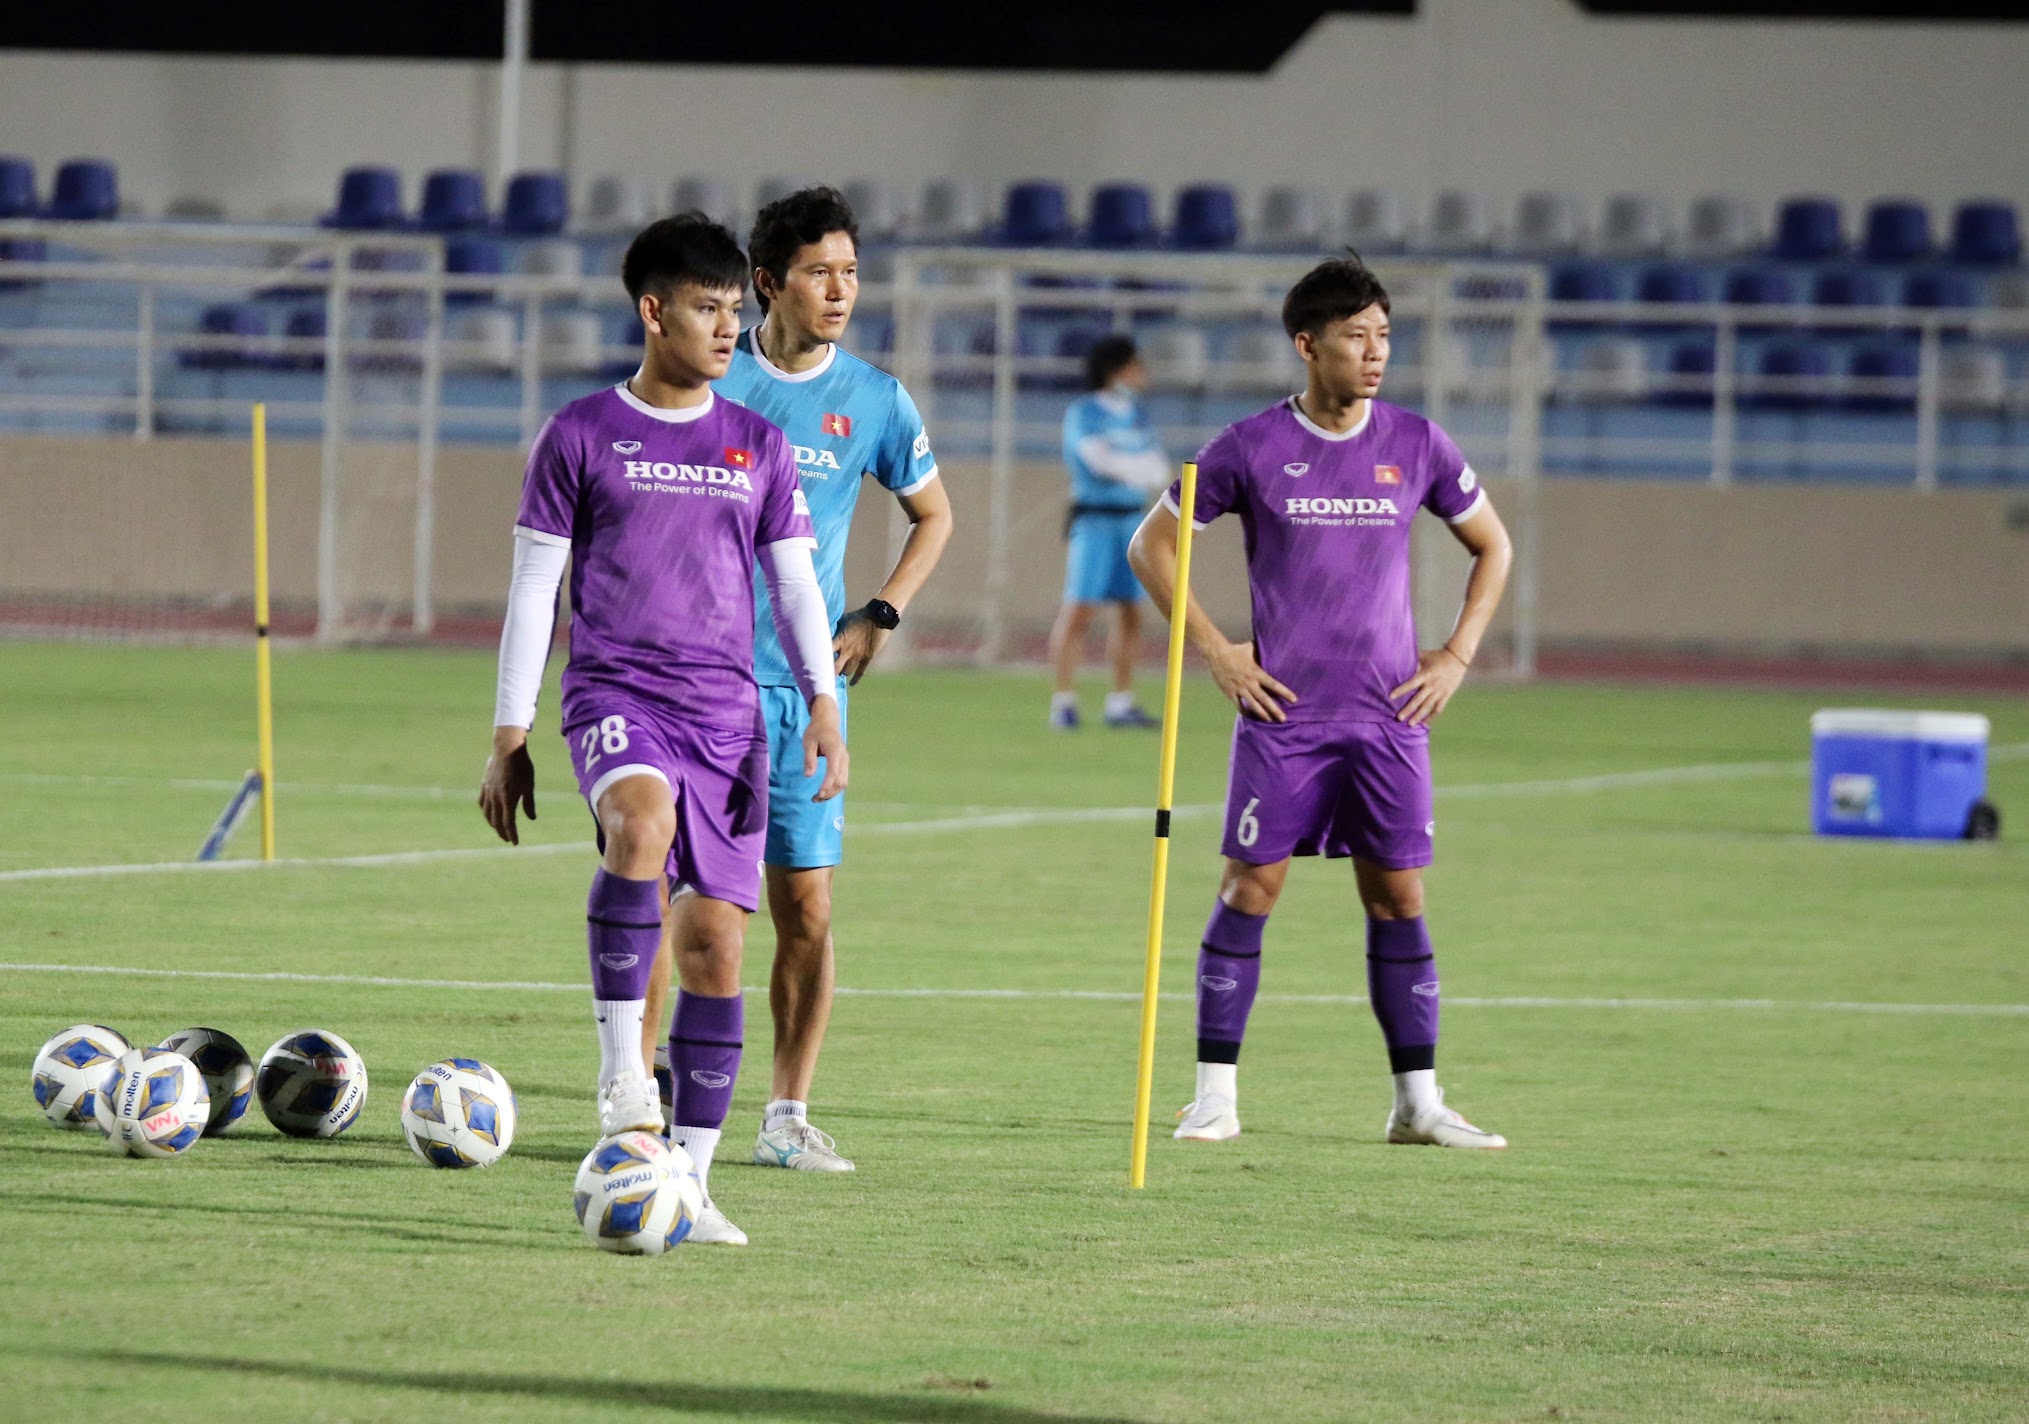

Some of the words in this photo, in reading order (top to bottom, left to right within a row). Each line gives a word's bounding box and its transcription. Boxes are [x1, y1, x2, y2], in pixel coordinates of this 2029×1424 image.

[790, 444, 841, 470] DA
[623, 460, 753, 491] HONDA
[797, 468, 829, 480] reams
[629, 481, 653, 491] The
[653, 482, 691, 494] Power
[692, 485, 706, 495] of
[708, 486, 750, 503] Dreams
[1285, 497, 1399, 514] HONDA
[1290, 516, 1310, 526] The
[1311, 516, 1344, 526] Power
[1344, 516, 1356, 526] of
[1357, 516, 1396, 526] Dreams
[581, 714, 629, 774] 28
[1237, 797, 1261, 847] 6
[123, 1071, 142, 1116] molten
[329, 1085, 359, 1124] molten
[603, 1170, 653, 1192] molten
